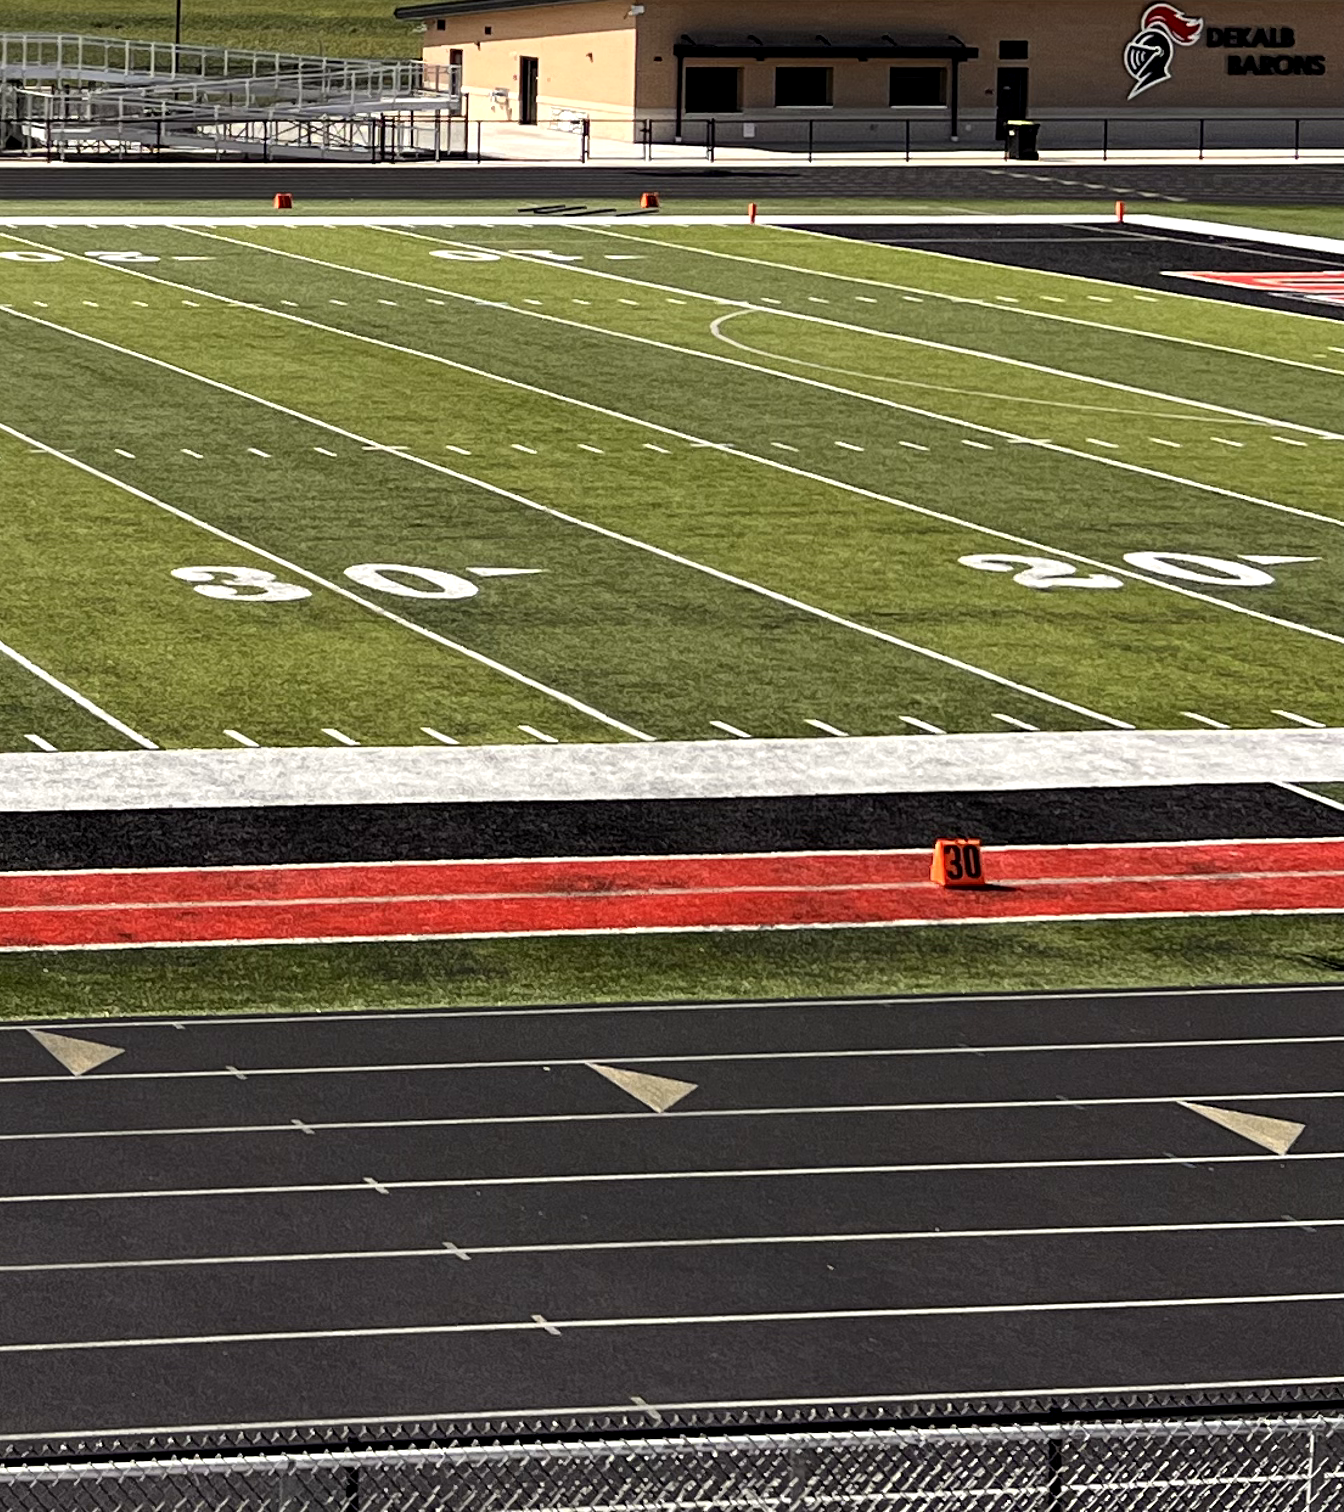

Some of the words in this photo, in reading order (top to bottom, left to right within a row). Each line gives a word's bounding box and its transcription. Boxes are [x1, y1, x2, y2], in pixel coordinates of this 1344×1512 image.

[1206, 27, 1296, 49] DEKALB
[1227, 55, 1326, 76] BARONS
[943, 845, 982, 880] 30
